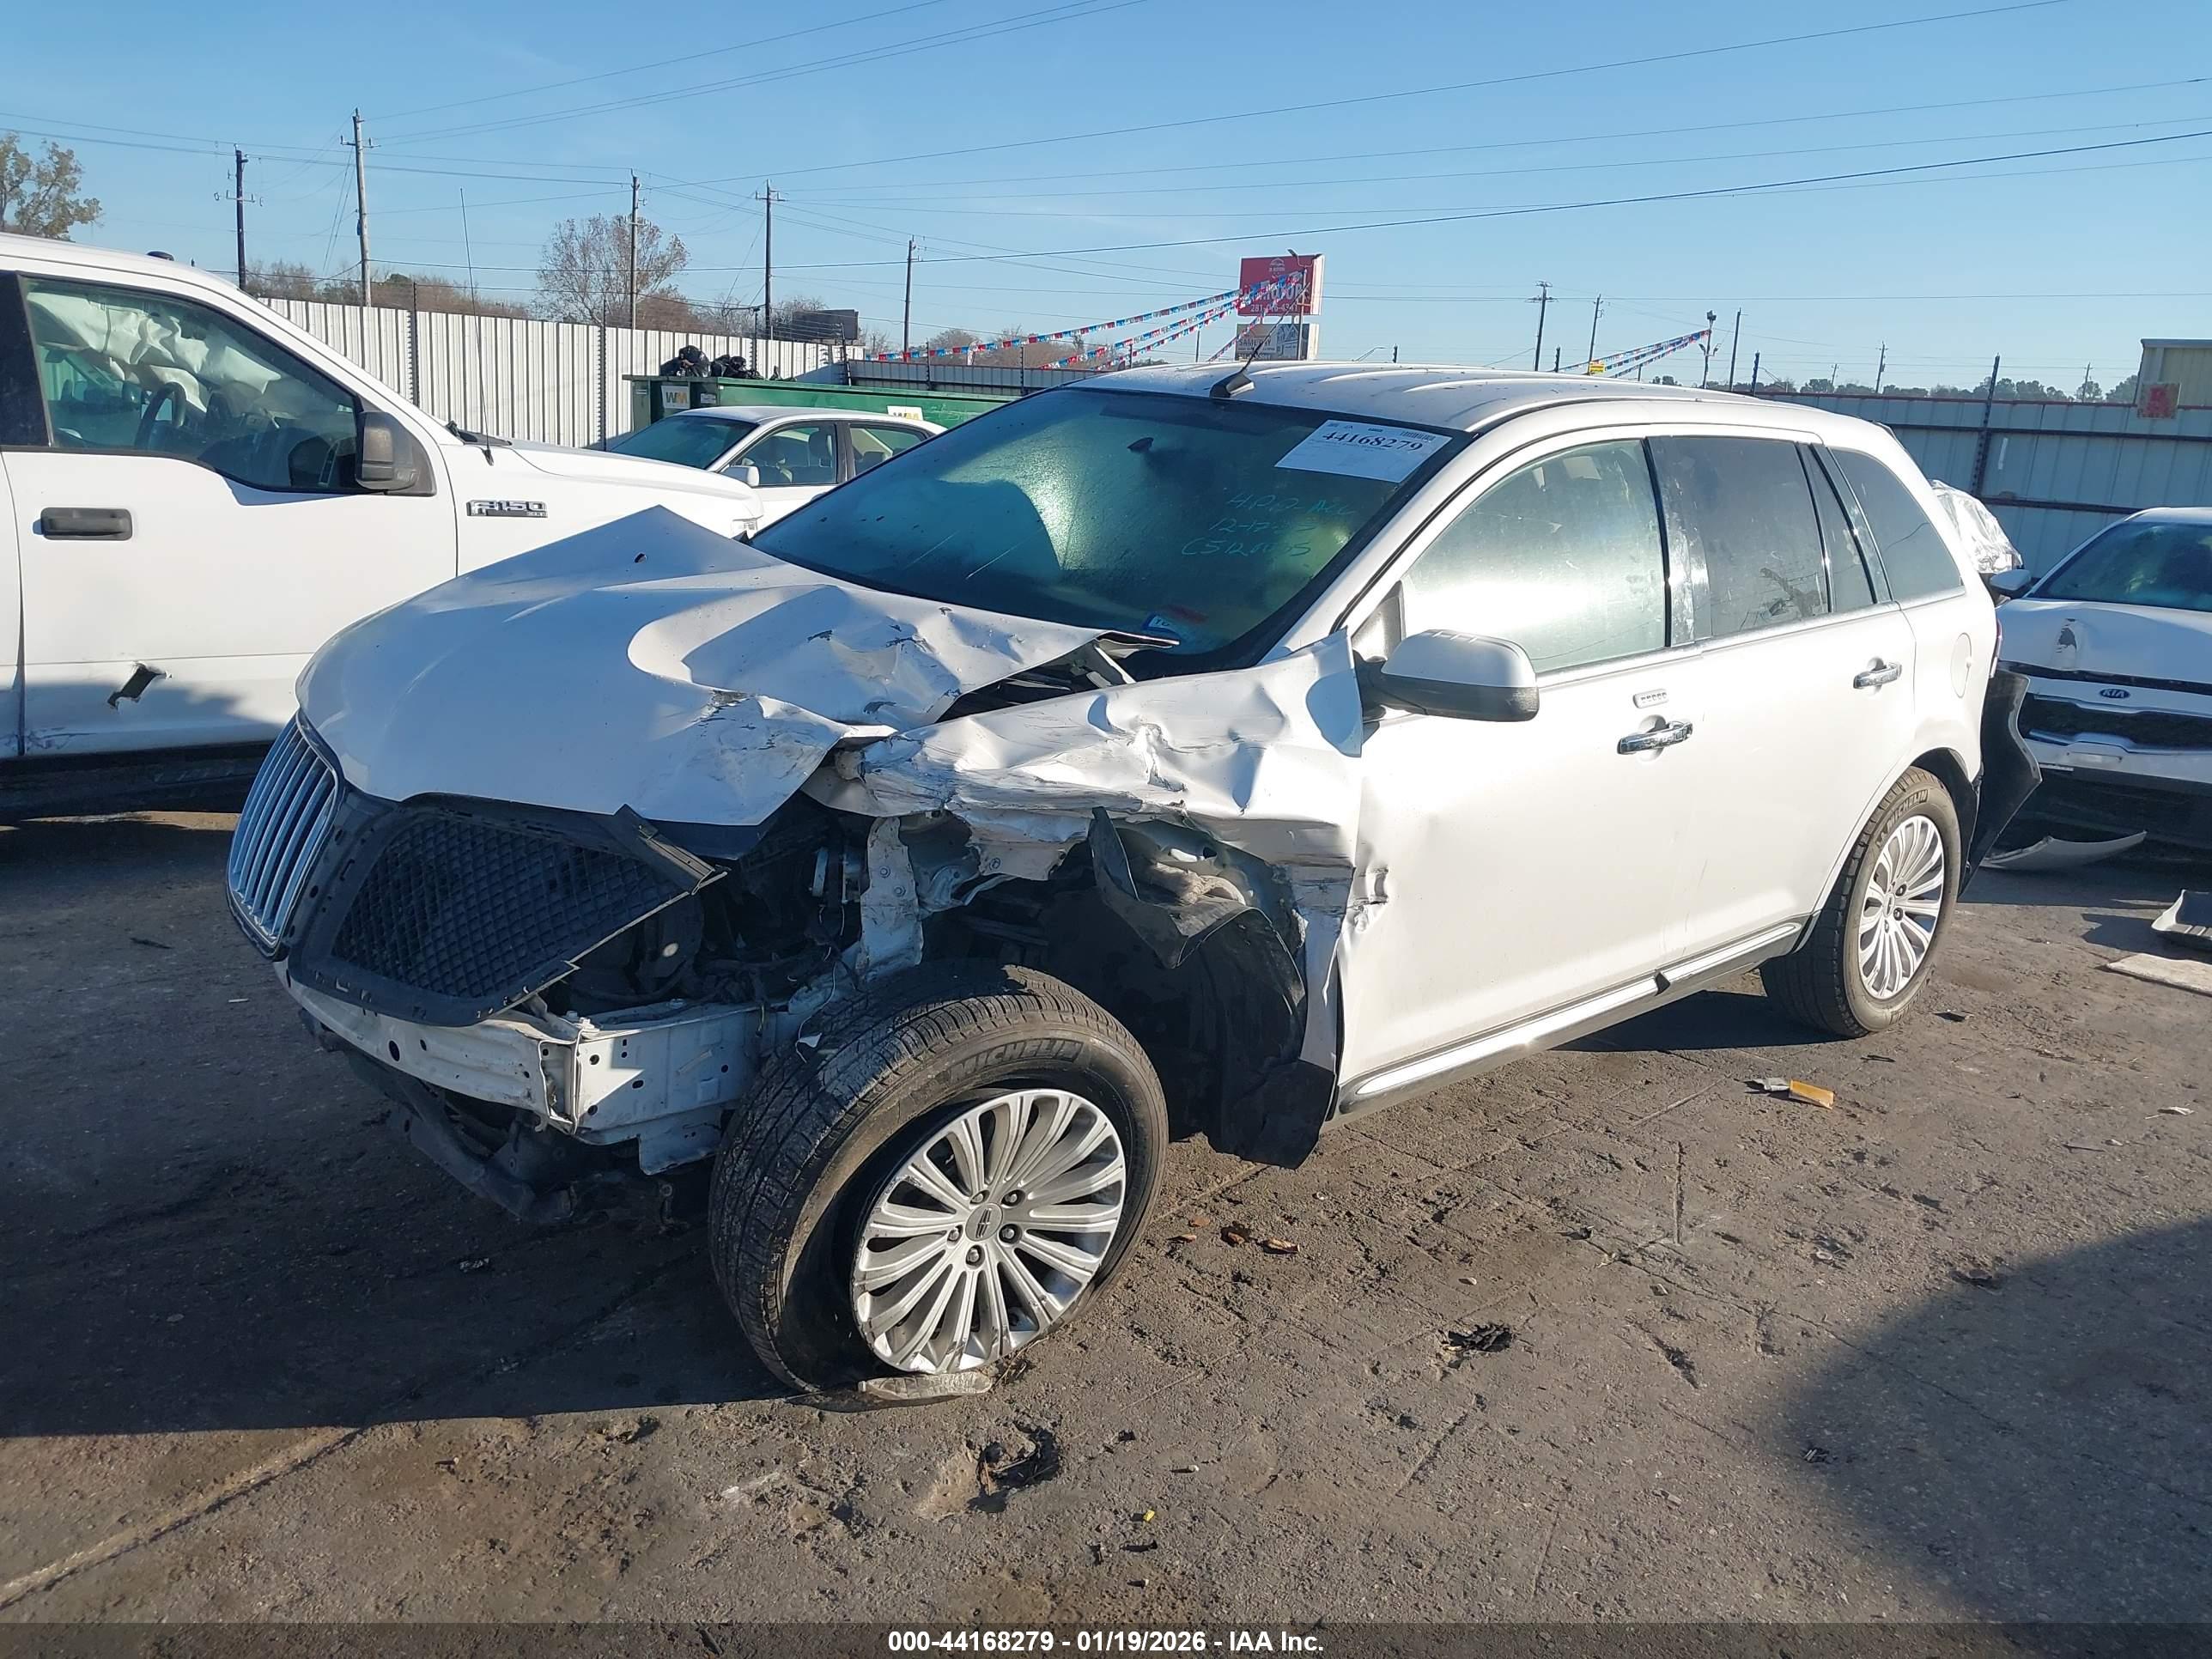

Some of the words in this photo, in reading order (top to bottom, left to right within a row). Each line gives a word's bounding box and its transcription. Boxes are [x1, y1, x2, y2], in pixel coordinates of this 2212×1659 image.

[665, 392, 688, 404] WM
[1322, 431, 1423, 451] 44168279
[945, 1037, 1084, 1088] MICHELIN
